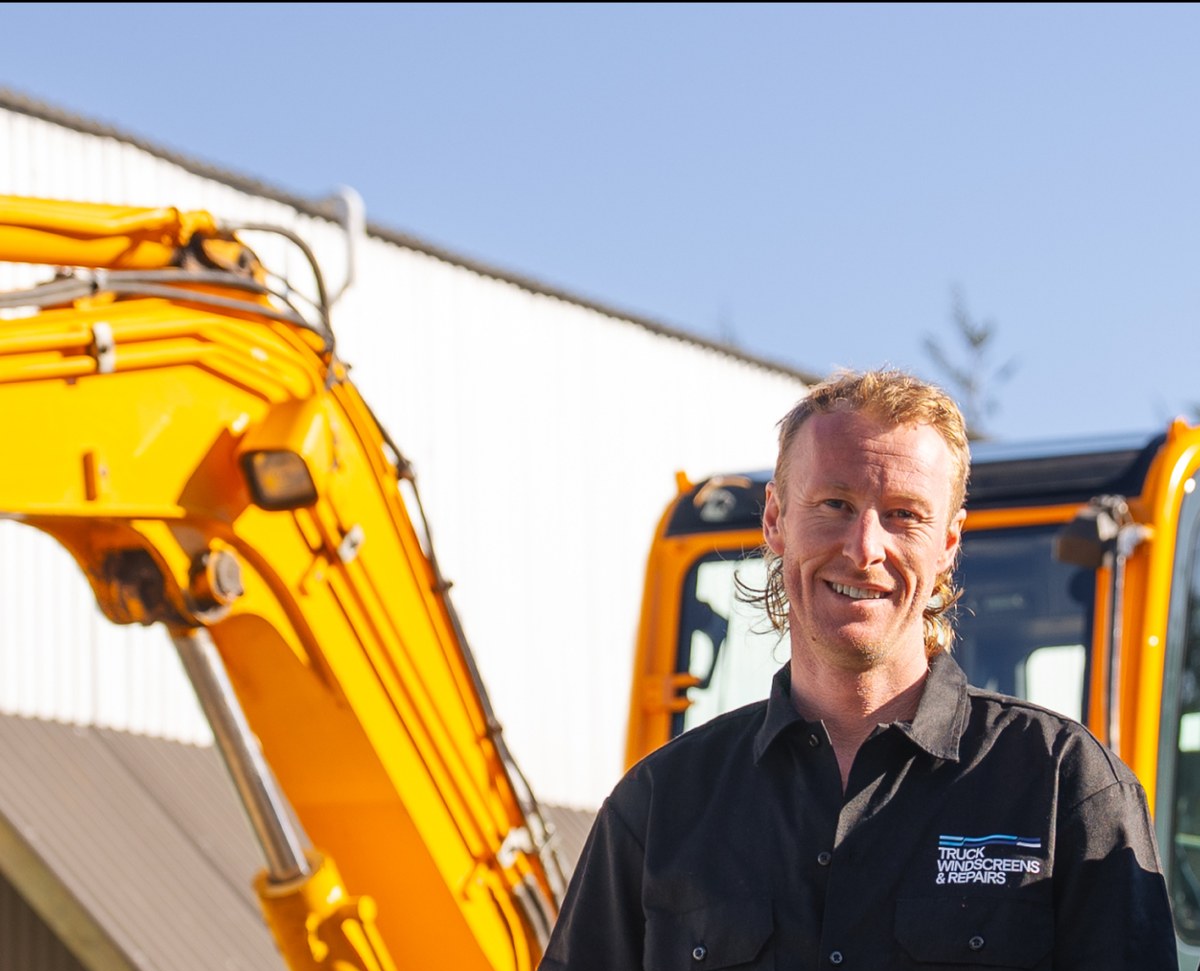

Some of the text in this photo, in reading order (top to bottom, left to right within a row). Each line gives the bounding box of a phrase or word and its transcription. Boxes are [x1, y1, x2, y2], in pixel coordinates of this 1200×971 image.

[938, 846, 986, 860] TRUCK
[937, 858, 1041, 874] WINDSCREENS
[935, 871, 1007, 885] & REPAIRS
